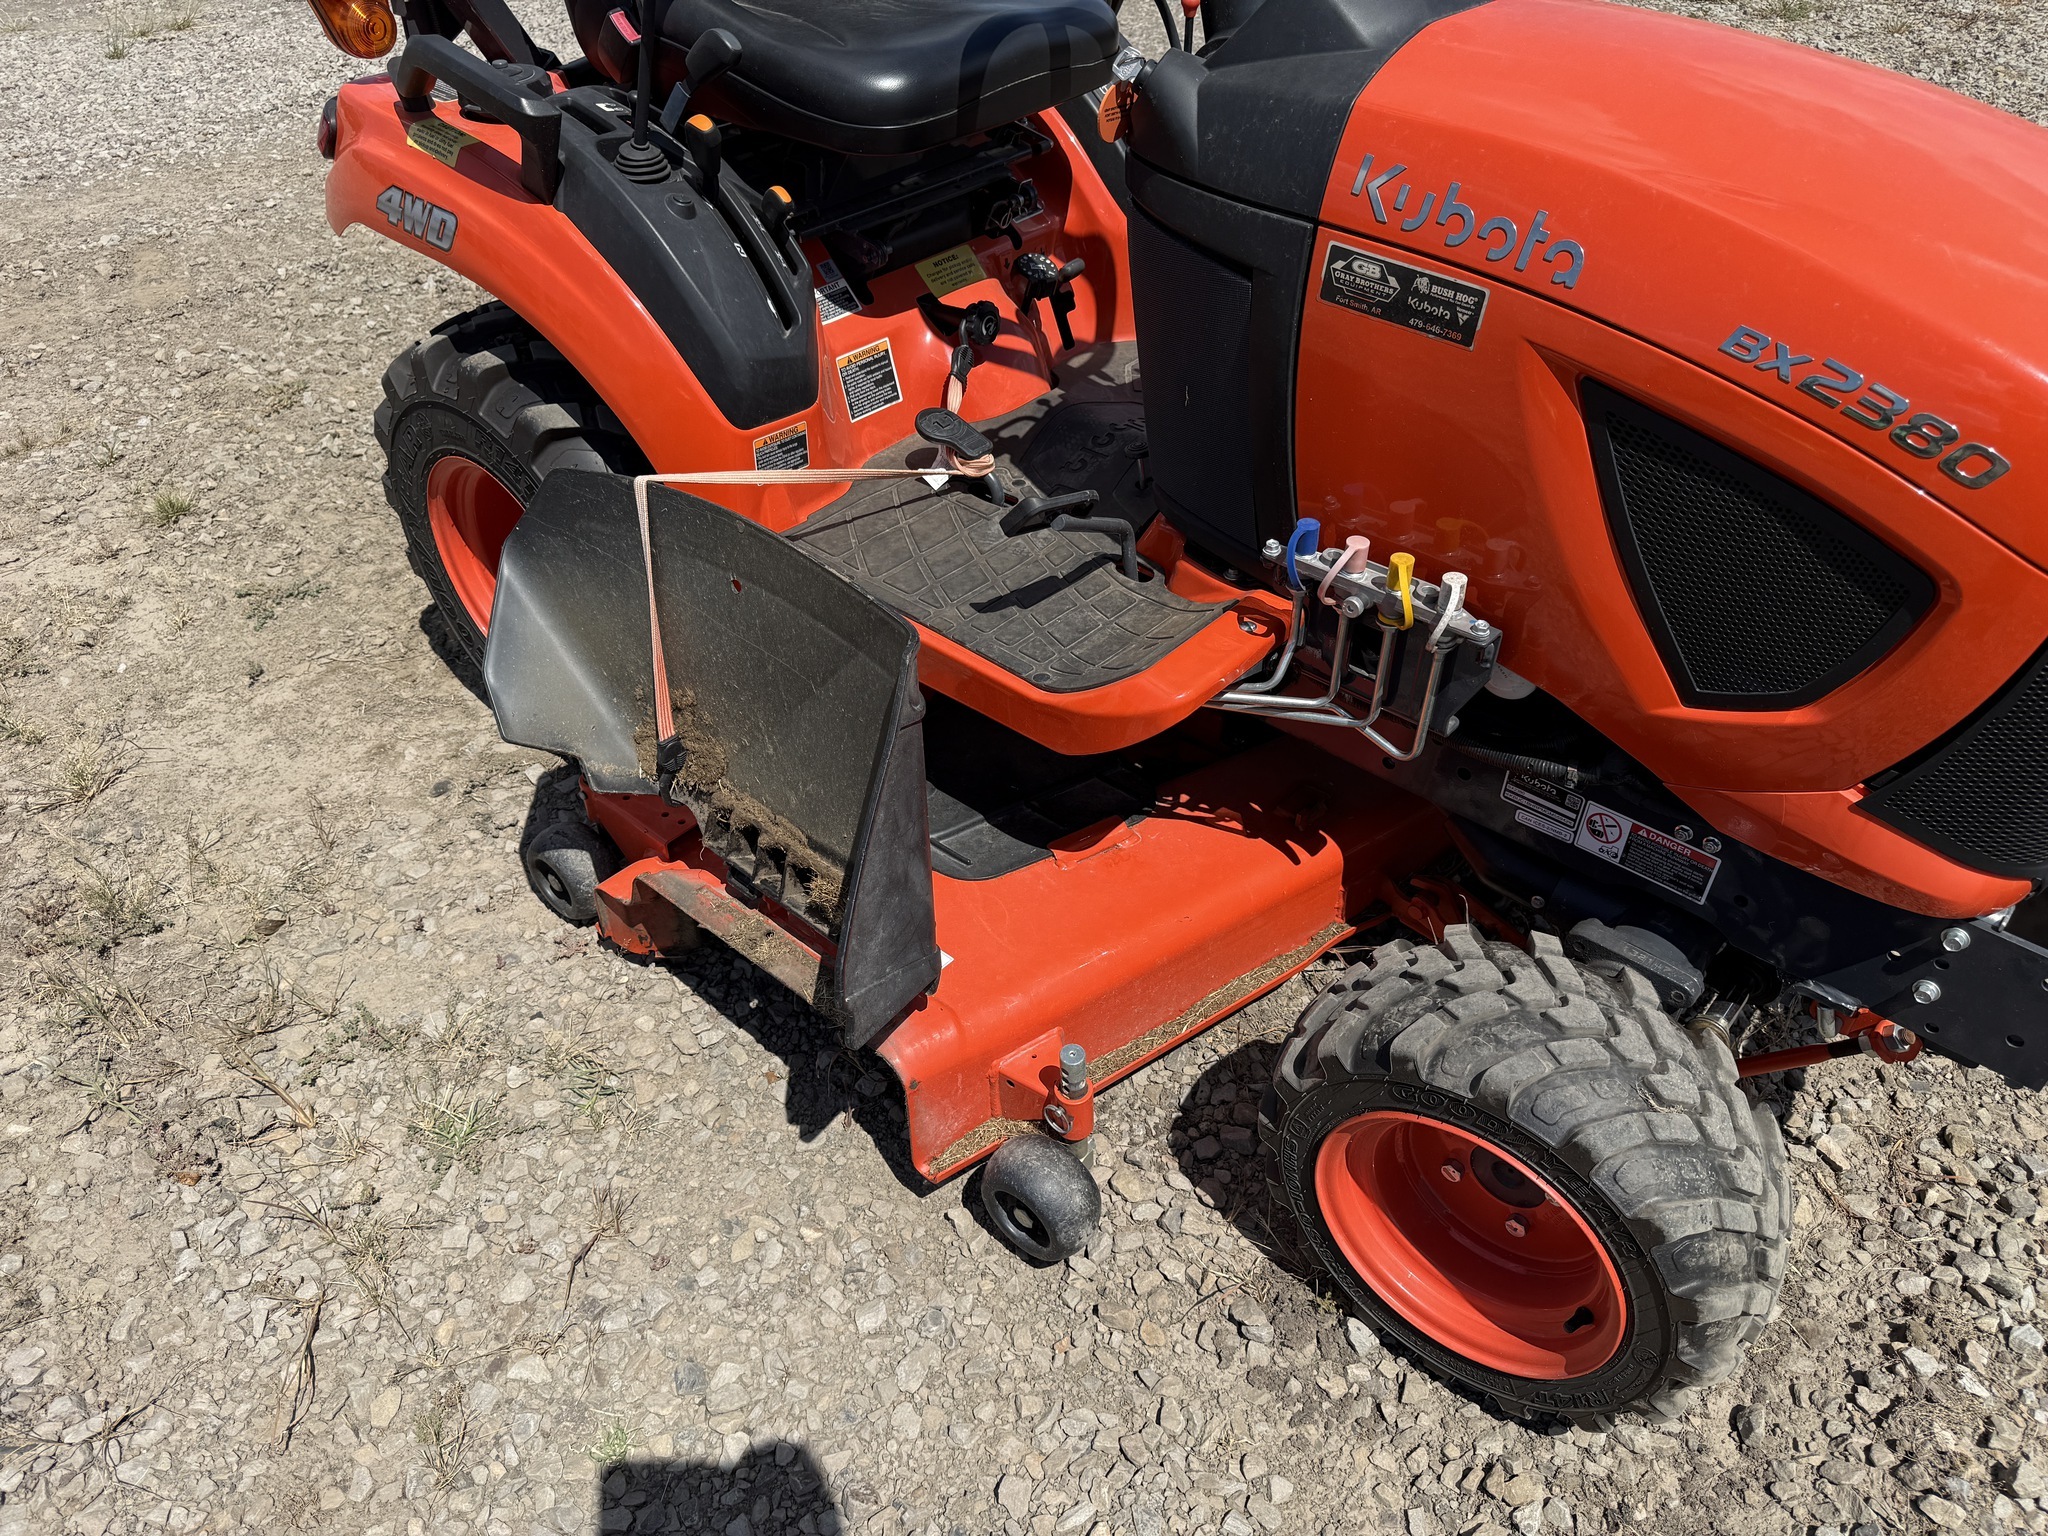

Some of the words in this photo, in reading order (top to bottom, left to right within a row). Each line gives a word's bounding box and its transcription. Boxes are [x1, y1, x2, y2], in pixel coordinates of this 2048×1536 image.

[376, 187, 457, 252] 4WD
[1350, 154, 1585, 289] Kubota
[932, 254, 959, 268] NOTICE:
[1351, 259, 1382, 279] GB
[1335, 271, 1355, 282] GRAY
[1355, 278, 1394, 294] BROTHERS
[1339, 280, 1387, 297] EQUIPMENT
[1431, 285, 1455, 298] BUSH
[1336, 295, 1349, 304] Fort
[1349, 300, 1370, 311] Smith,
[1371, 307, 1382, 315] AR
[1407, 297, 1452, 319] Kubota
[1408, 318, 1463, 341] 479-646-7369
[852, 346, 880, 360] WARNING
[1718, 325, 2011, 490] BX2380
[768, 426, 799, 442] WARNING
[1521, 774, 1558, 794] Kubota
[1649, 833, 1692, 857] DANGER
[1392, 1084, 1638, 1260] GOODYEAR
